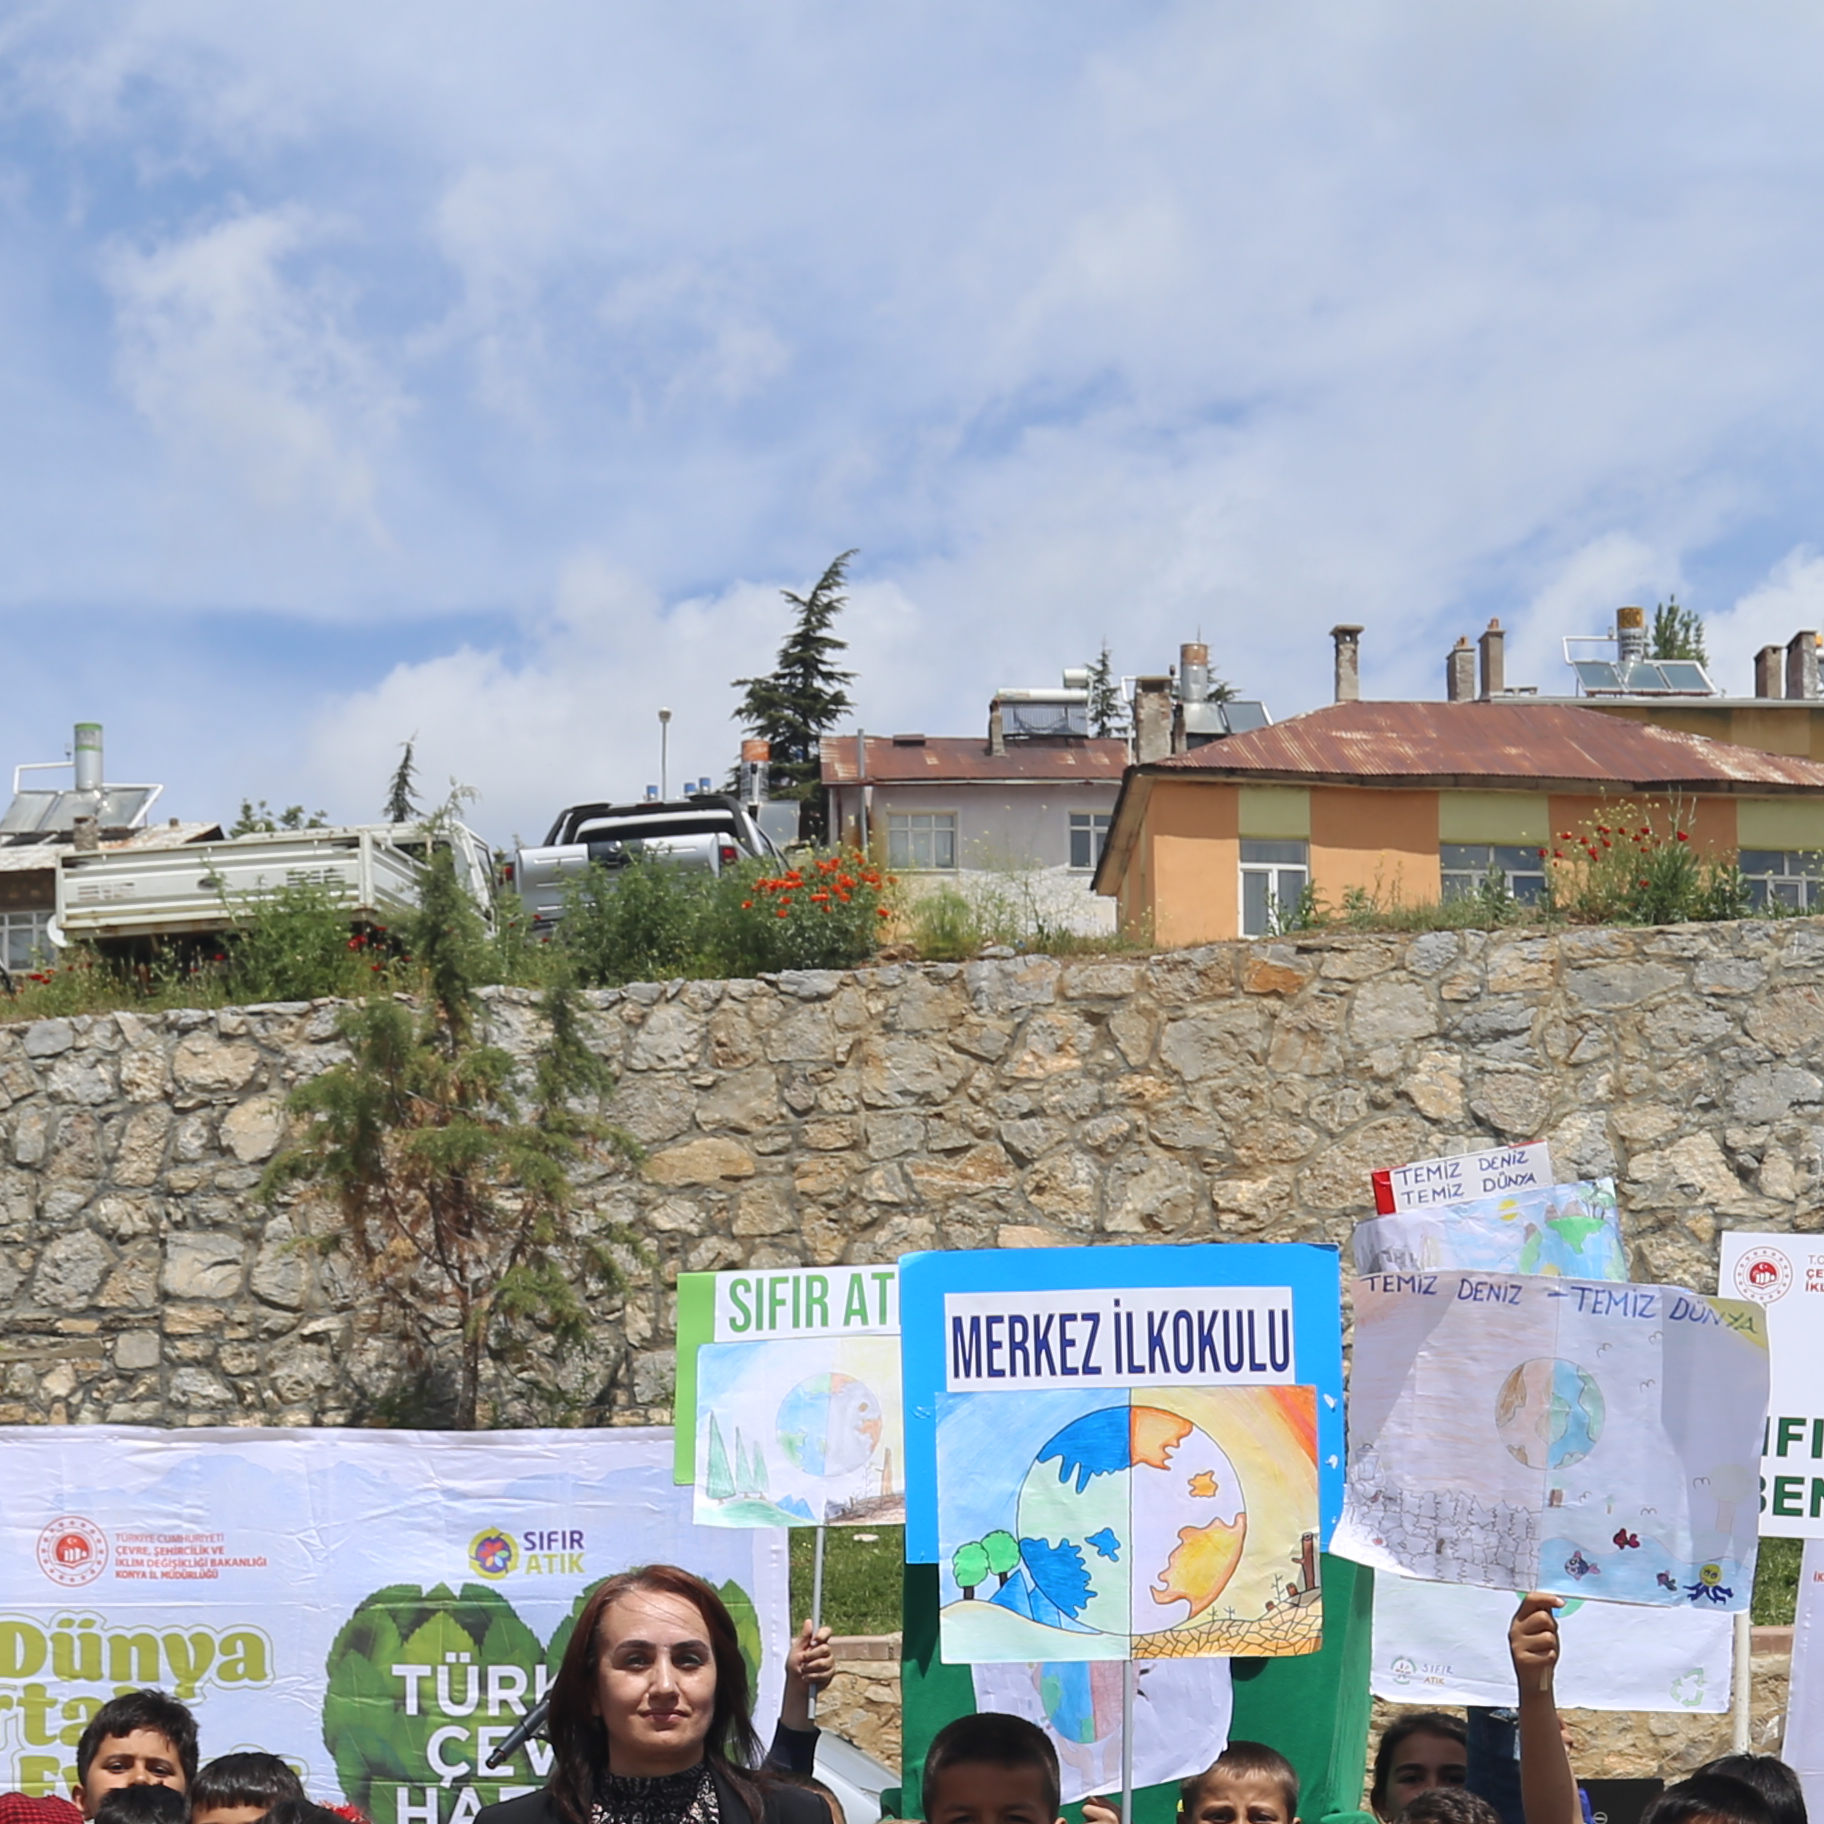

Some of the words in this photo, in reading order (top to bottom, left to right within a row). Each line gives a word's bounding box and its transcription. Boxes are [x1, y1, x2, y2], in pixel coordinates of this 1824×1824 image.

[1395, 1161, 1463, 1187] TEMİZ
[1478, 1149, 1530, 1173] DENİZ
[1400, 1182, 1465, 1206] TEMİZ
[1482, 1170, 1538, 1193] DÜNYA
[728, 1274, 829, 1334] SIFIR
[843, 1271, 896, 1327] AT
[1359, 1274, 1438, 1296] TEMİZ
[1457, 1278, 1523, 1305] DENİZ
[1669, 1297, 1758, 1334] DÜNYA
[950, 1312, 1103, 1380] MERKEZ
[1112, 1297, 1291, 1376] İLKOKULU
[210, 1545, 225, 1556] VE
[523, 1529, 585, 1551] SIFIR
[114, 1557, 145, 1568] İKLİM
[210, 1556, 267, 1568] BAKANLIĞI
[114, 1569, 147, 1579] KONYA
[525, 1552, 587, 1575] ATIK
[426, 1725, 560, 1788] ÇEV
